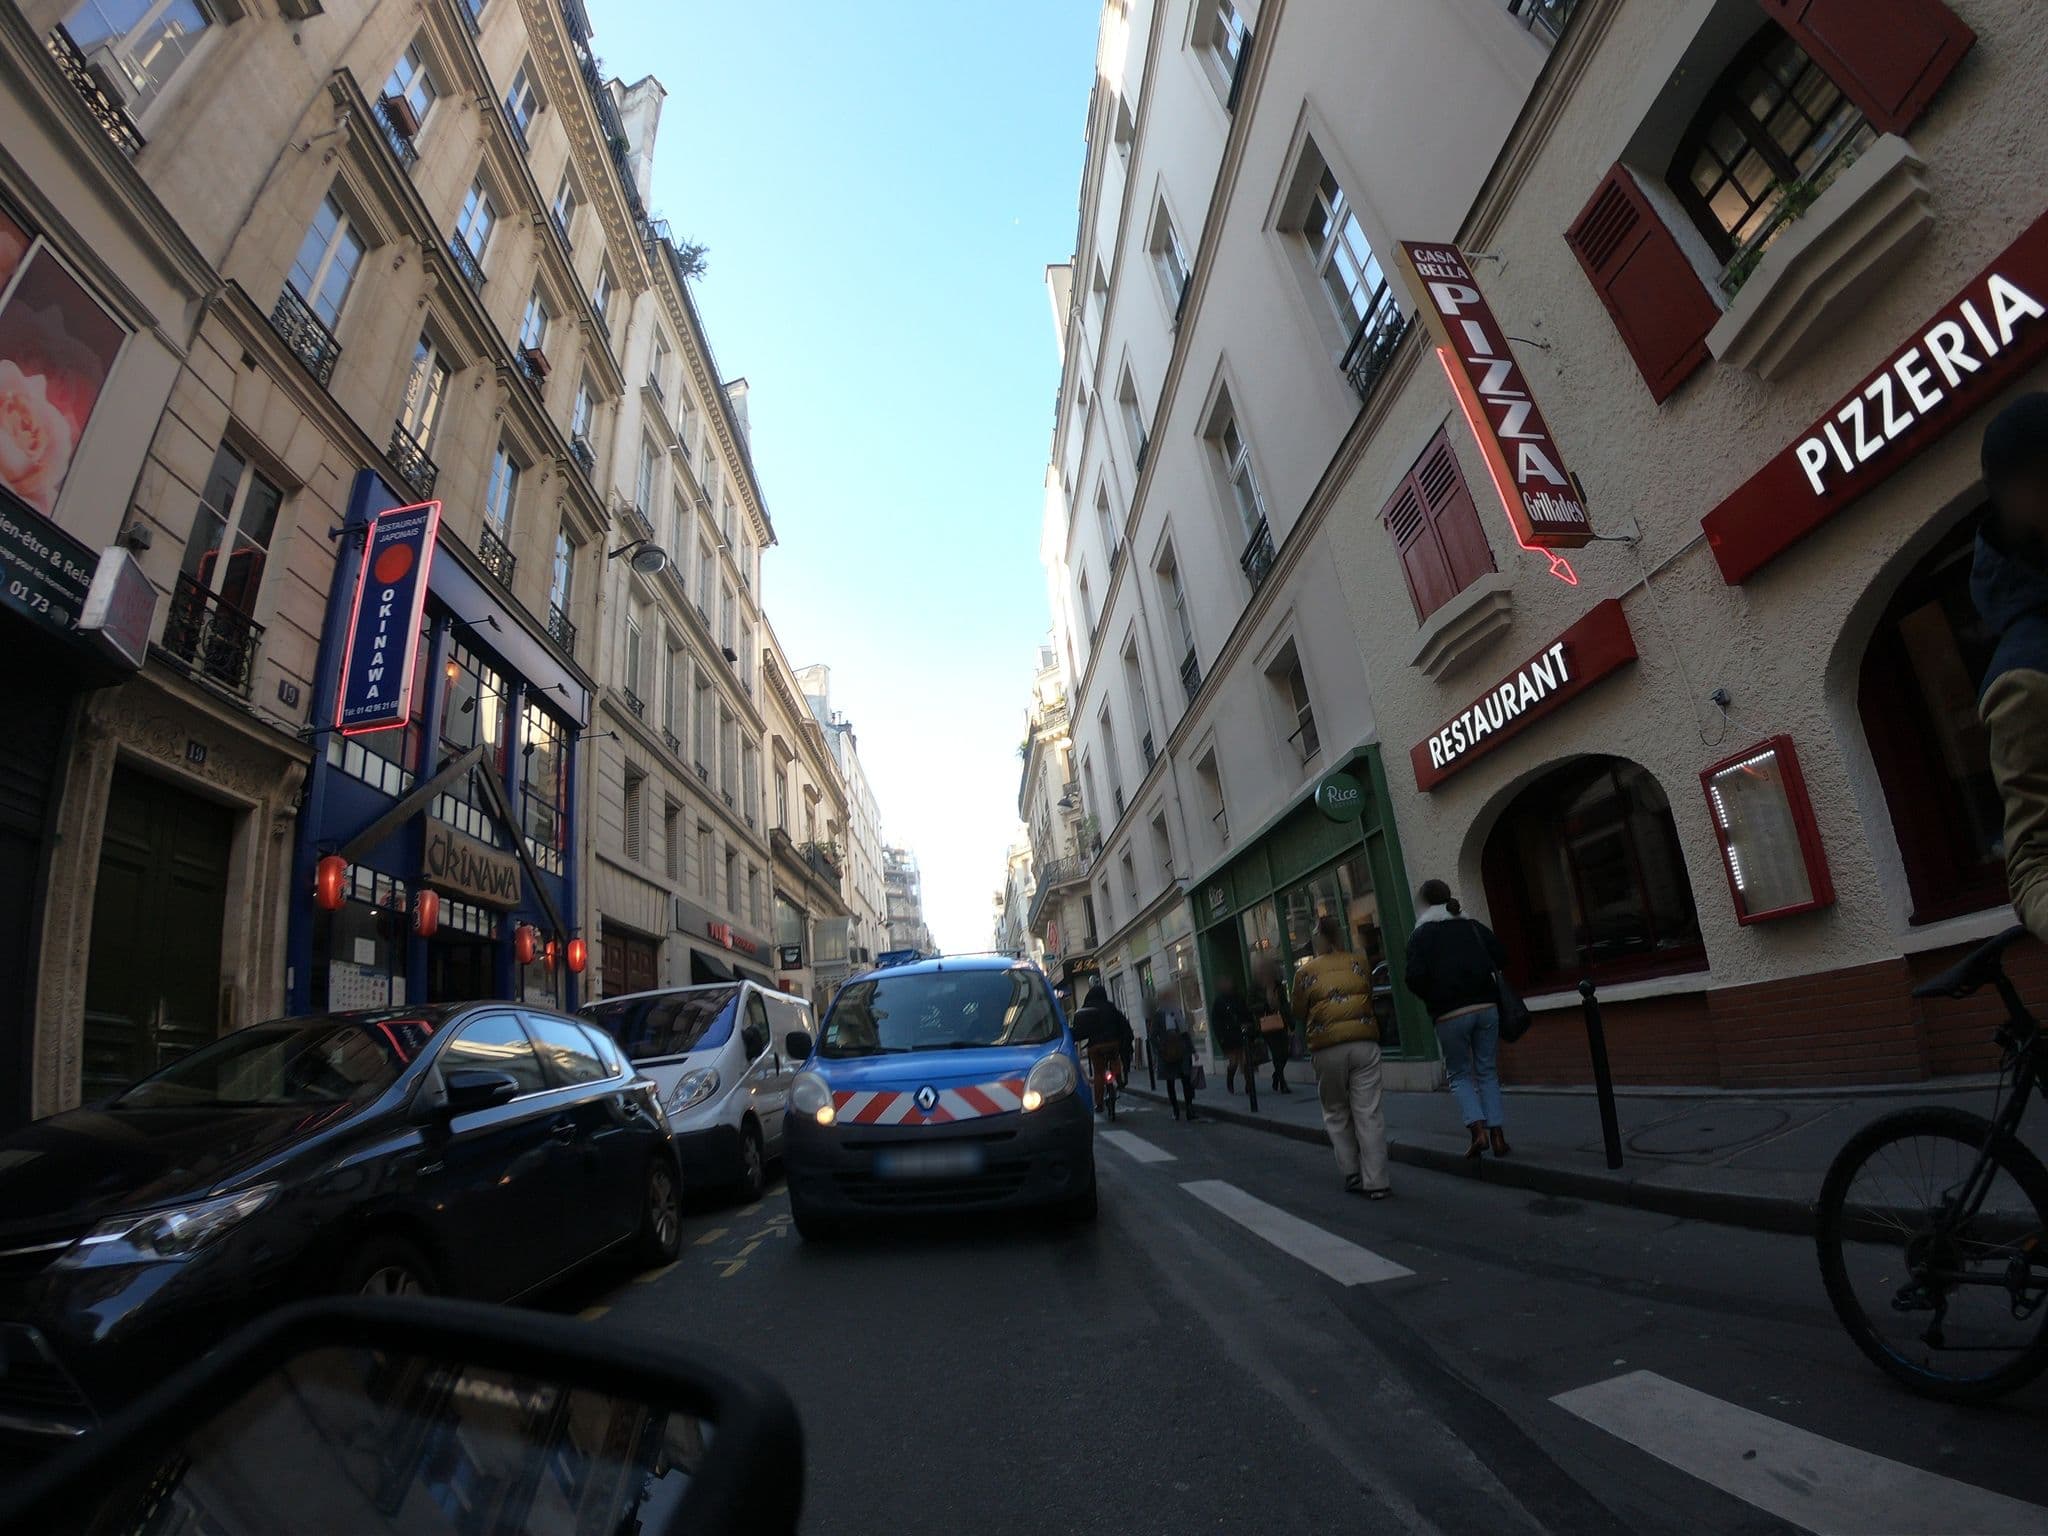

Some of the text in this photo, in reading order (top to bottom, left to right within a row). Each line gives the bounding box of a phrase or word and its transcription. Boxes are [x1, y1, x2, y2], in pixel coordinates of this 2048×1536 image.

[1413, 249, 1457, 265] CASA
[1416, 262, 1469, 280] BELLA
[1428, 281, 1568, 486] PIZZA
[1796, 273, 2046, 496] PIZZERIA
[1522, 491, 1585, 524] Grillades
[376, 515, 428, 533] RESTAURANT
[379, 527, 421, 543] JAPONAIS
[366, 588, 396, 700] OKINAWA
[282, 682, 297, 703] 19
[1428, 641, 1569, 770] RESTAURANT
[1326, 785, 1359, 803] Rice
